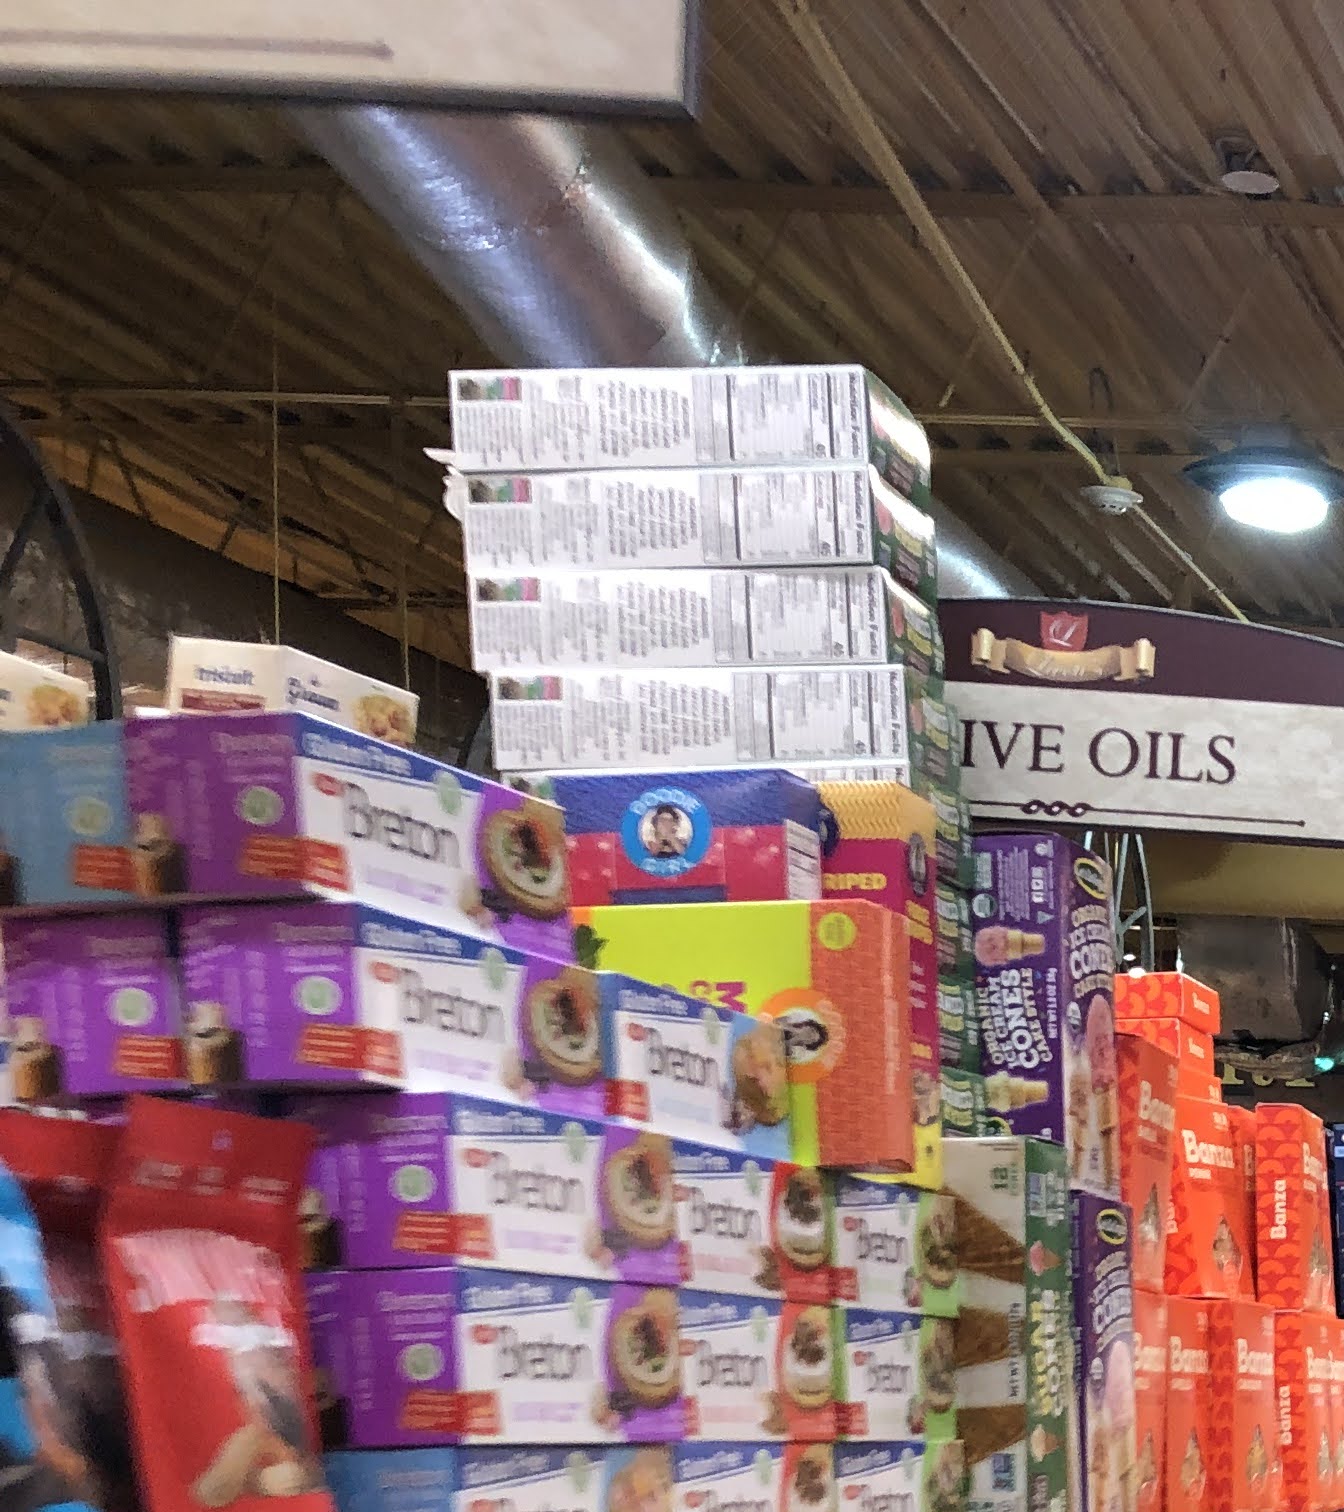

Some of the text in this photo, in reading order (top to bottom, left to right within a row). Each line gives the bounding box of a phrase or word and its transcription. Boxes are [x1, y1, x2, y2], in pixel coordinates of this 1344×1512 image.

[1088, 726, 1237, 785] OILS
[1000, 968, 1041, 1069] CONES
[1181, 1129, 1235, 1168] Banza
[1270, 1180, 1286, 1239] Banza
[1279, 1386, 1292, 1445] Banza
